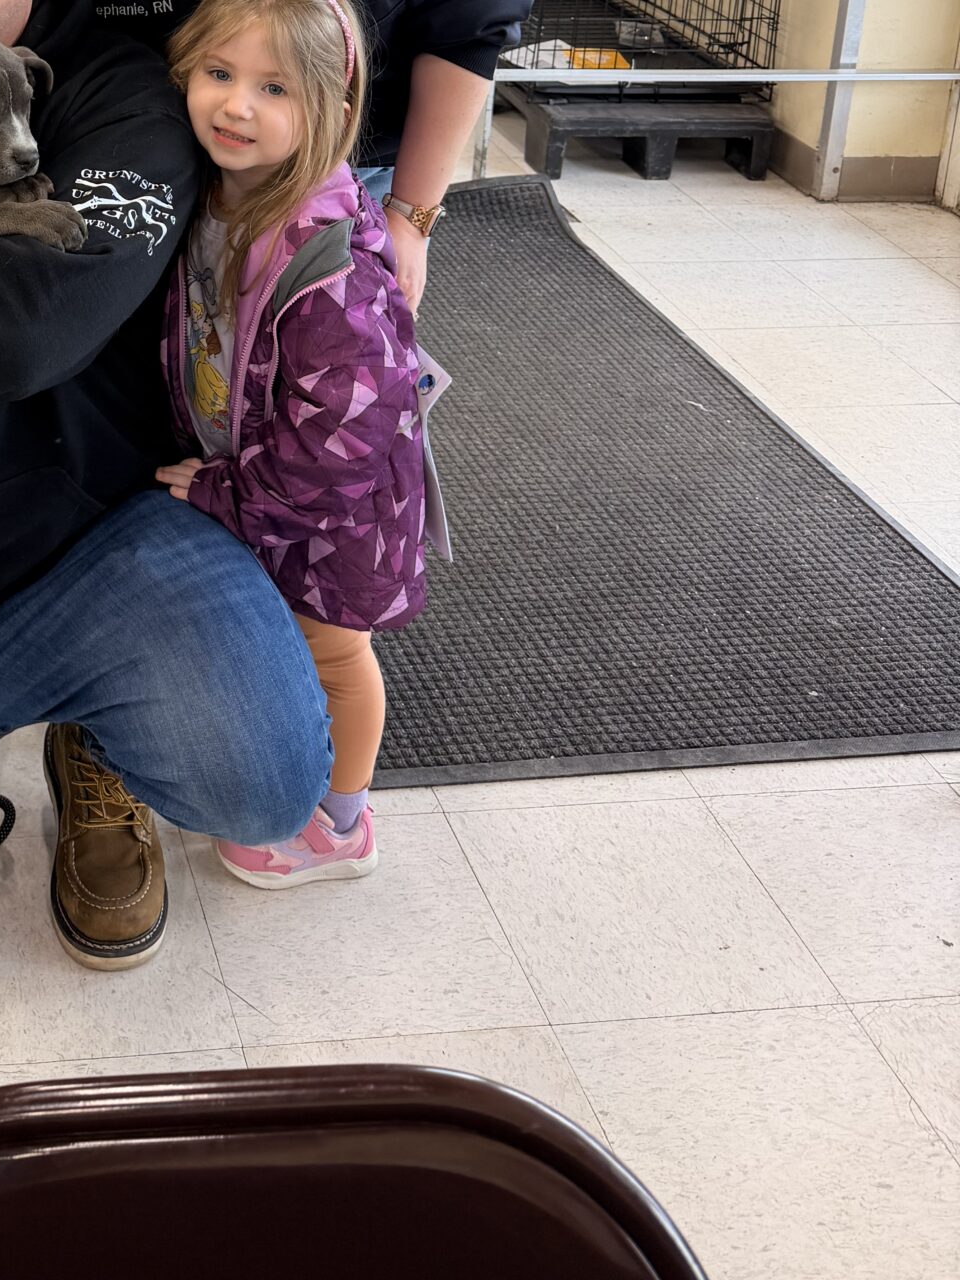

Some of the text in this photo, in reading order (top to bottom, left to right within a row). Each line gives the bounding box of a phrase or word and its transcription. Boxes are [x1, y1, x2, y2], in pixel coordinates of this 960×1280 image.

[96, 0, 173, 19] ephanie, RN
[80, 168, 142, 184] GRUNT
